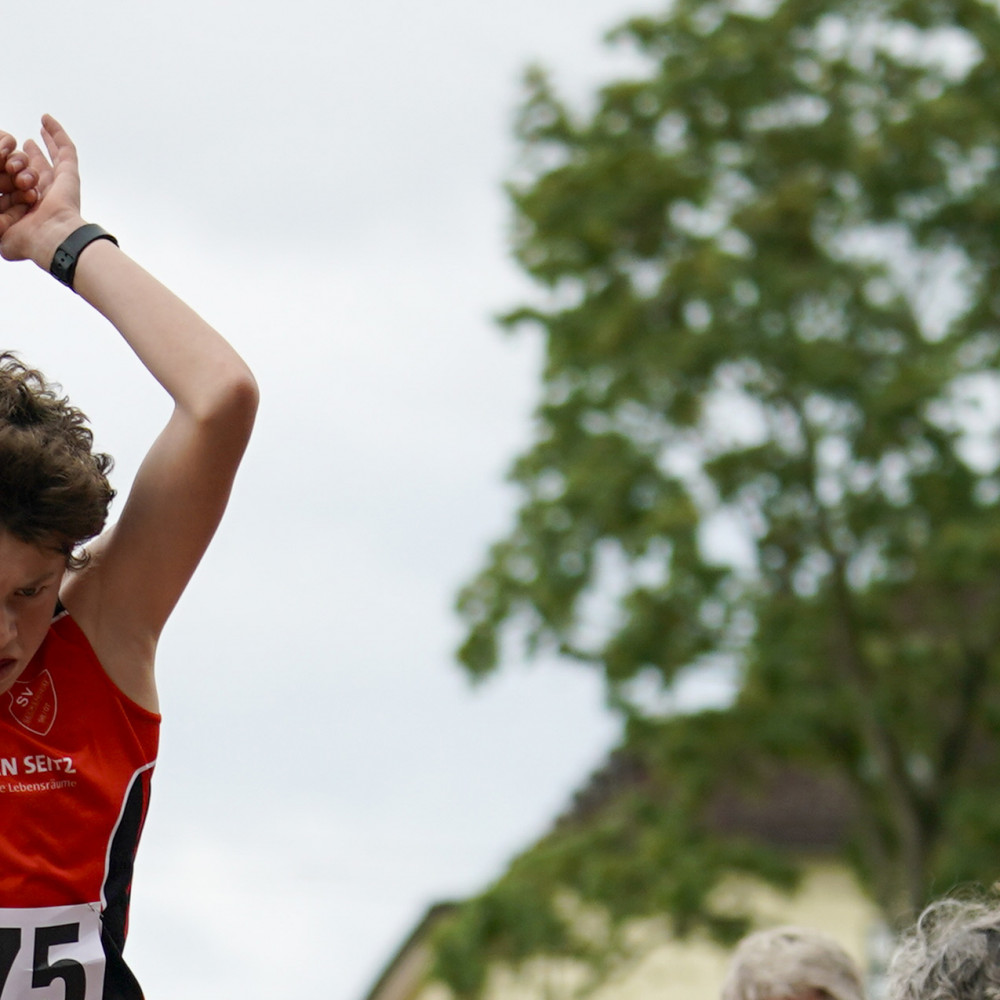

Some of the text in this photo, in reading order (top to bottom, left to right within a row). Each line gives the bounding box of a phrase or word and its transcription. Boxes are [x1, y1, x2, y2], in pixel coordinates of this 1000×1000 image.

[16, 687, 34, 707] SV
[23, 754, 77, 774] SEITZ
[8, 778, 77, 793] Lebensräume
